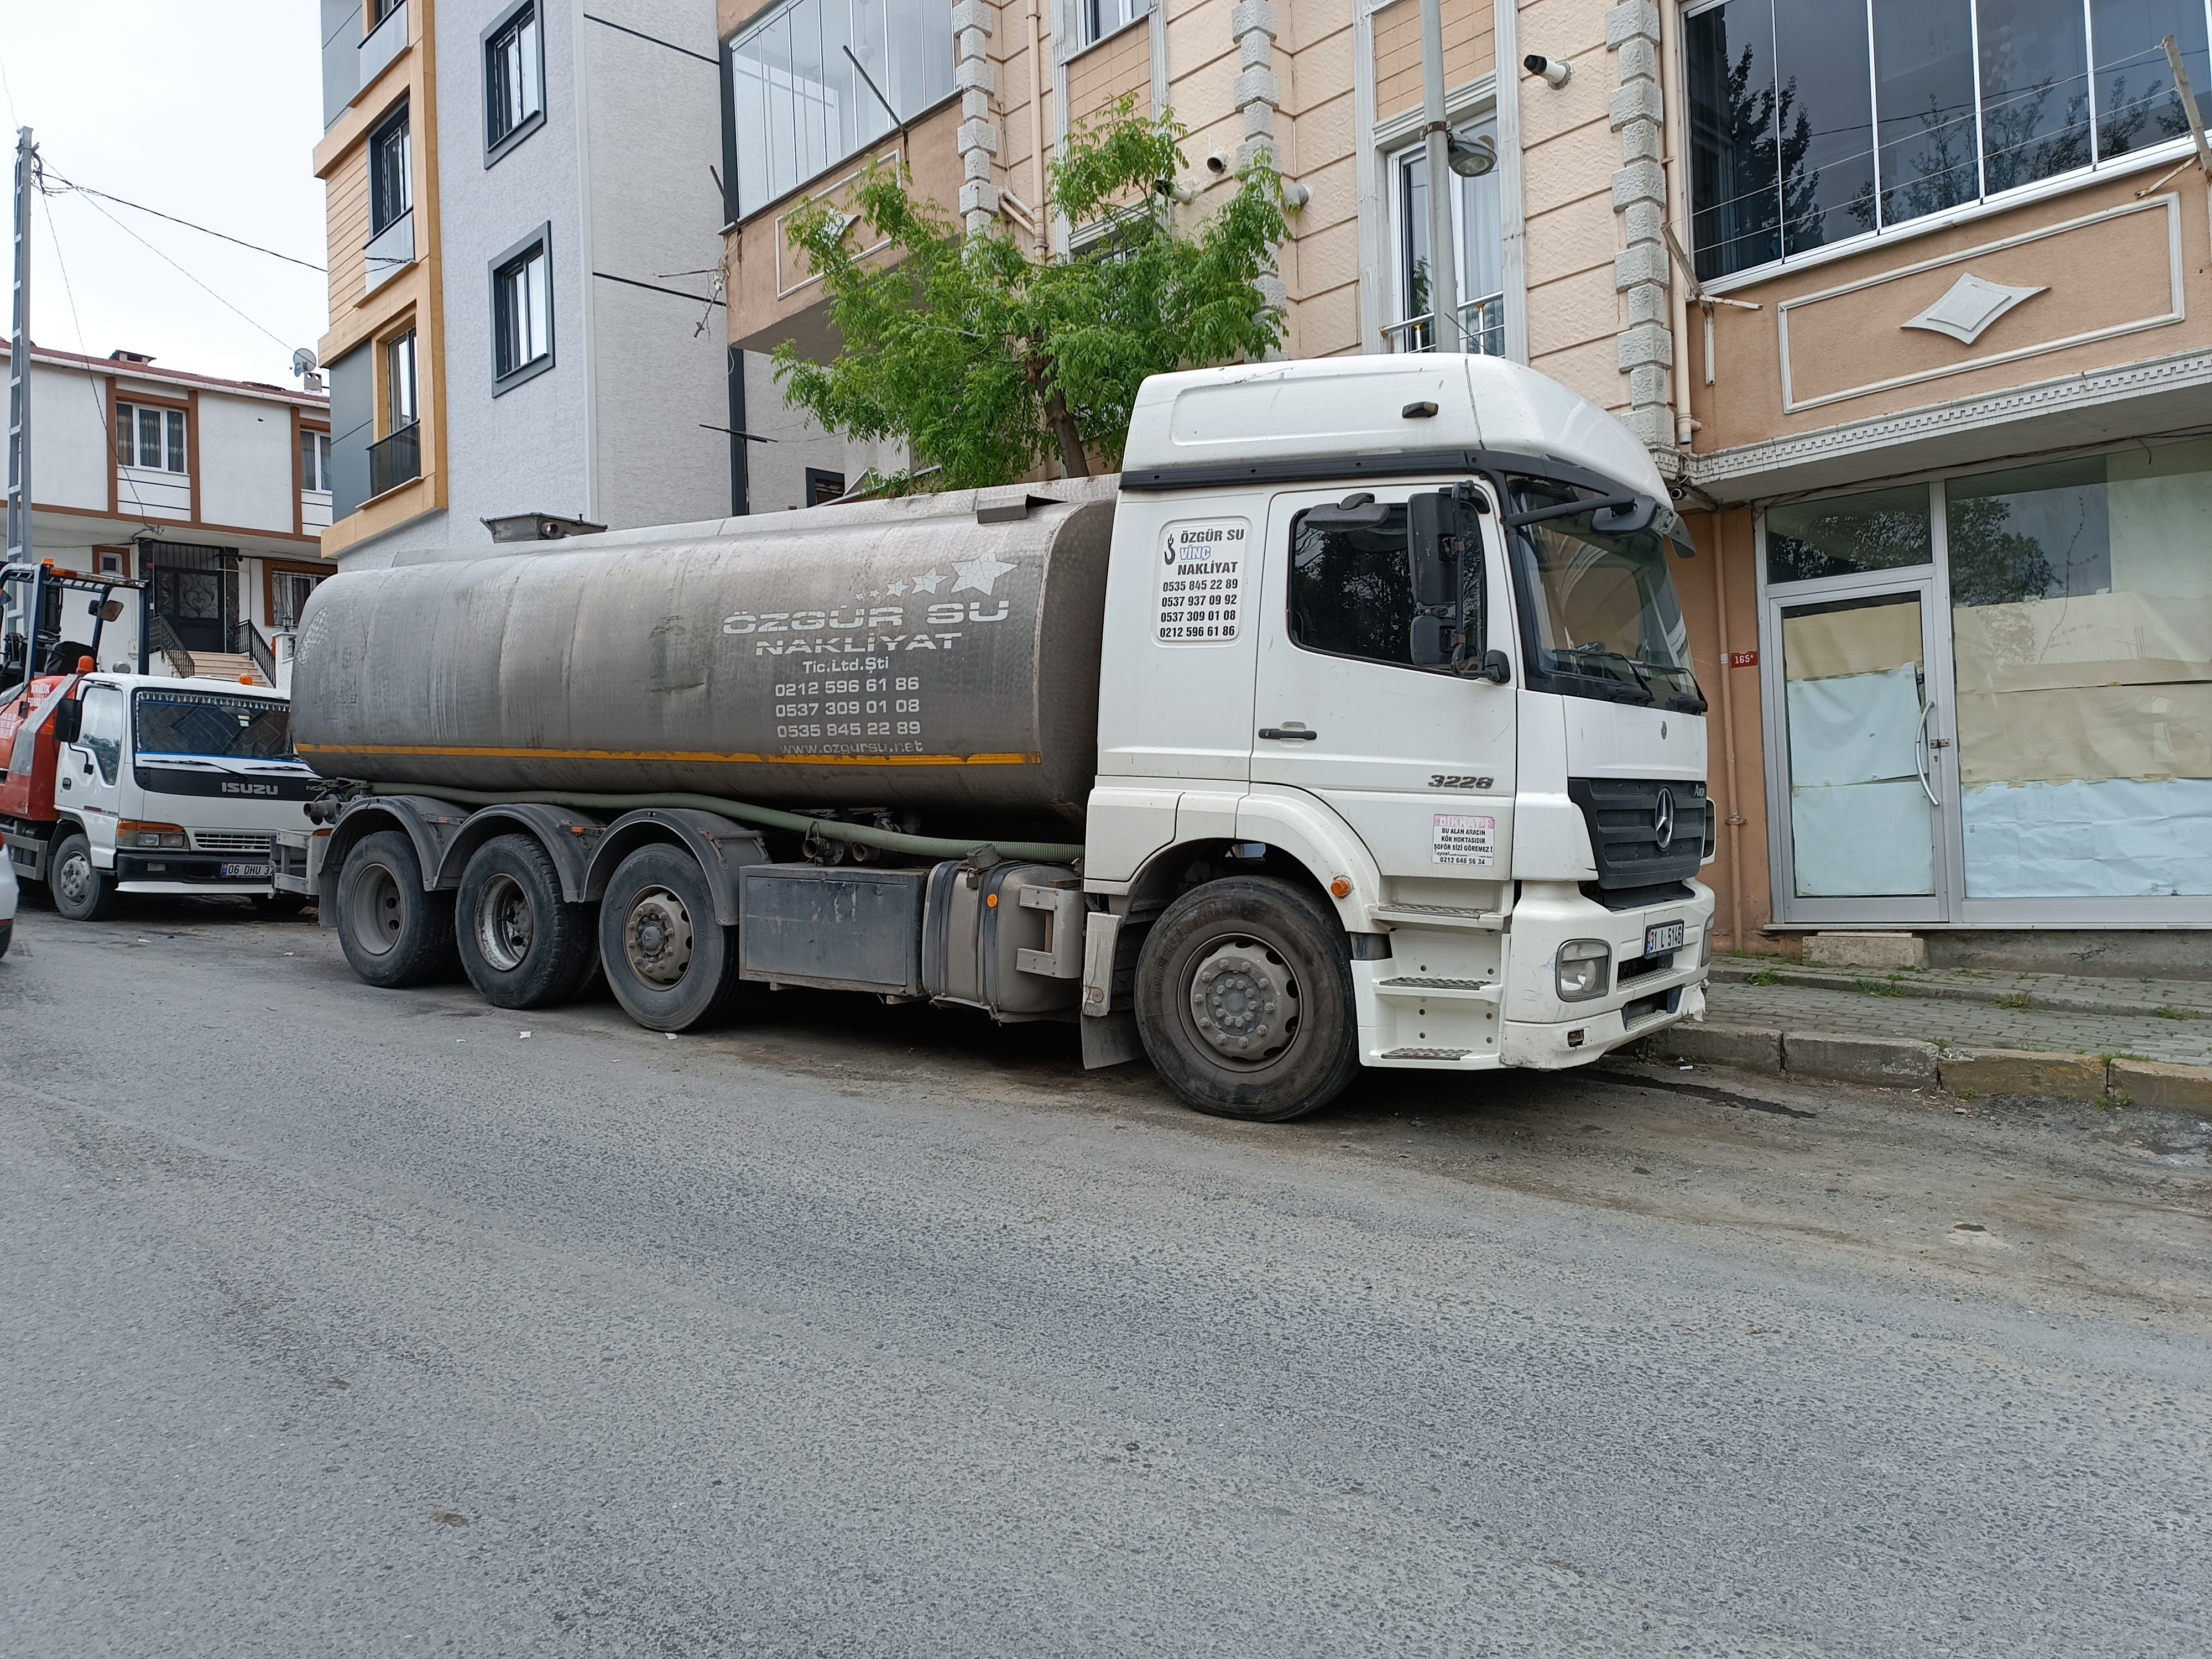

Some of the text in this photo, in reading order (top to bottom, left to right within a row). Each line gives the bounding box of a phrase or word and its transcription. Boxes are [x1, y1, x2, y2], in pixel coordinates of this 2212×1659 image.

[1181, 529, 1244, 544] ÖZGÜR SU
[1180, 545, 1211, 561] VİNÇ
[1177, 561, 1238, 575] NAKLİYAT
[1163, 579, 1238, 592] 0535 845 22 89
[1162, 594, 1237, 607] 0537 937 09 92
[722, 600, 1010, 634] ÖZGÜR SU
[1161, 610, 1236, 622] 0537 309 01 08
[1160, 625, 1235, 638] 0212 596 61 86
[755, 632, 962, 656] NAKLİYAT
[775, 677, 919, 697] 0212 596 61 86
[775, 699, 920, 717] 0537 309 01 08
[778, 721, 920, 739] 0535 845 22 89
[222, 782, 278, 795] ISUZU
[1428, 775, 1494, 789] 3228
[228, 865, 239, 874] 06
[244, 865, 261, 874] DHU
[1661, 930, 1664, 948] L
